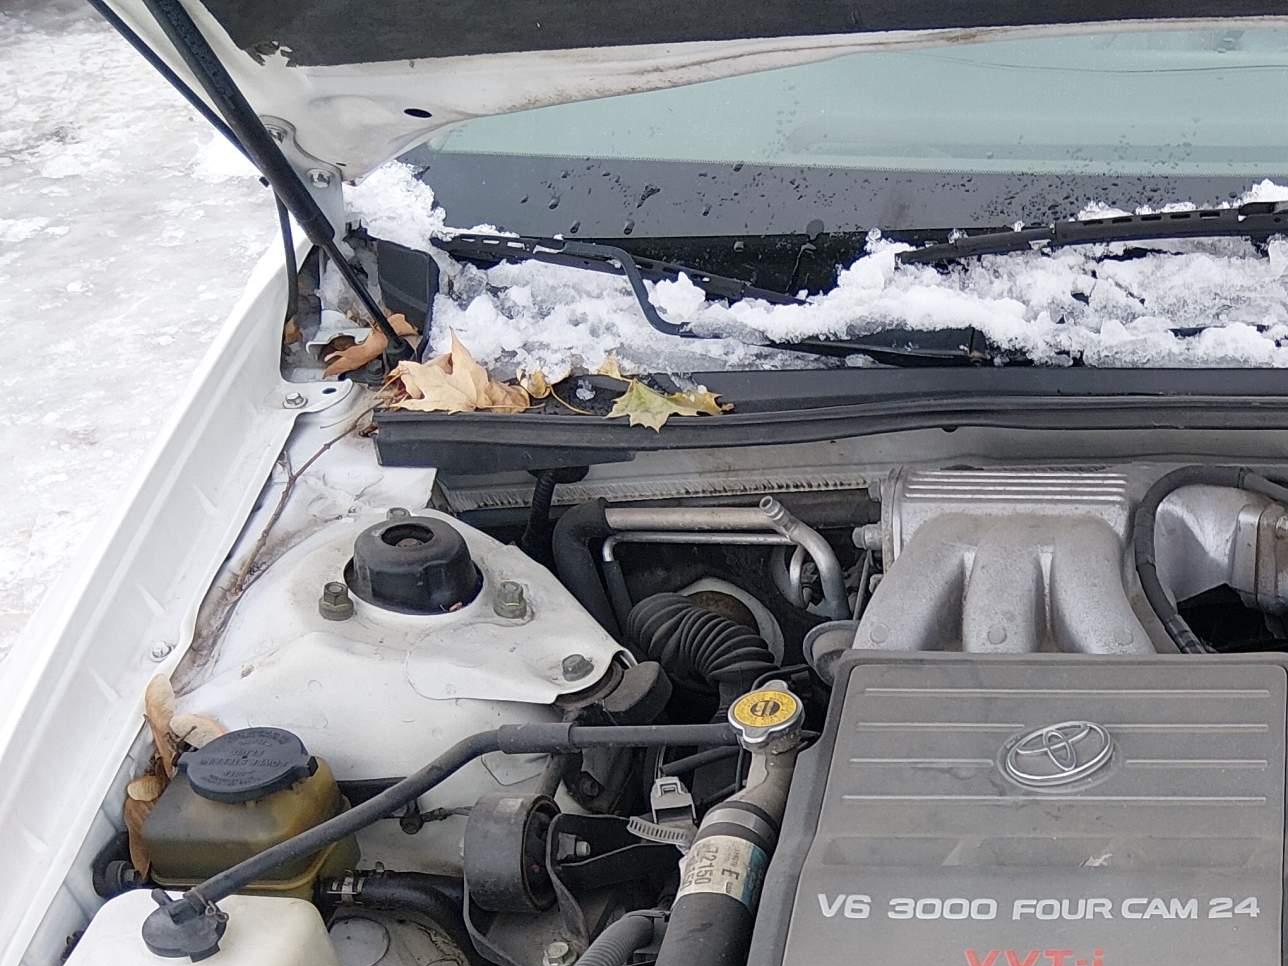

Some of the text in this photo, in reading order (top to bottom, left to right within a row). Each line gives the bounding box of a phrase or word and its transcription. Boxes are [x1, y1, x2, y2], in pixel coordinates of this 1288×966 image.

[818, 894, 1260, 921] V6 3000 FOUR CAM 24
